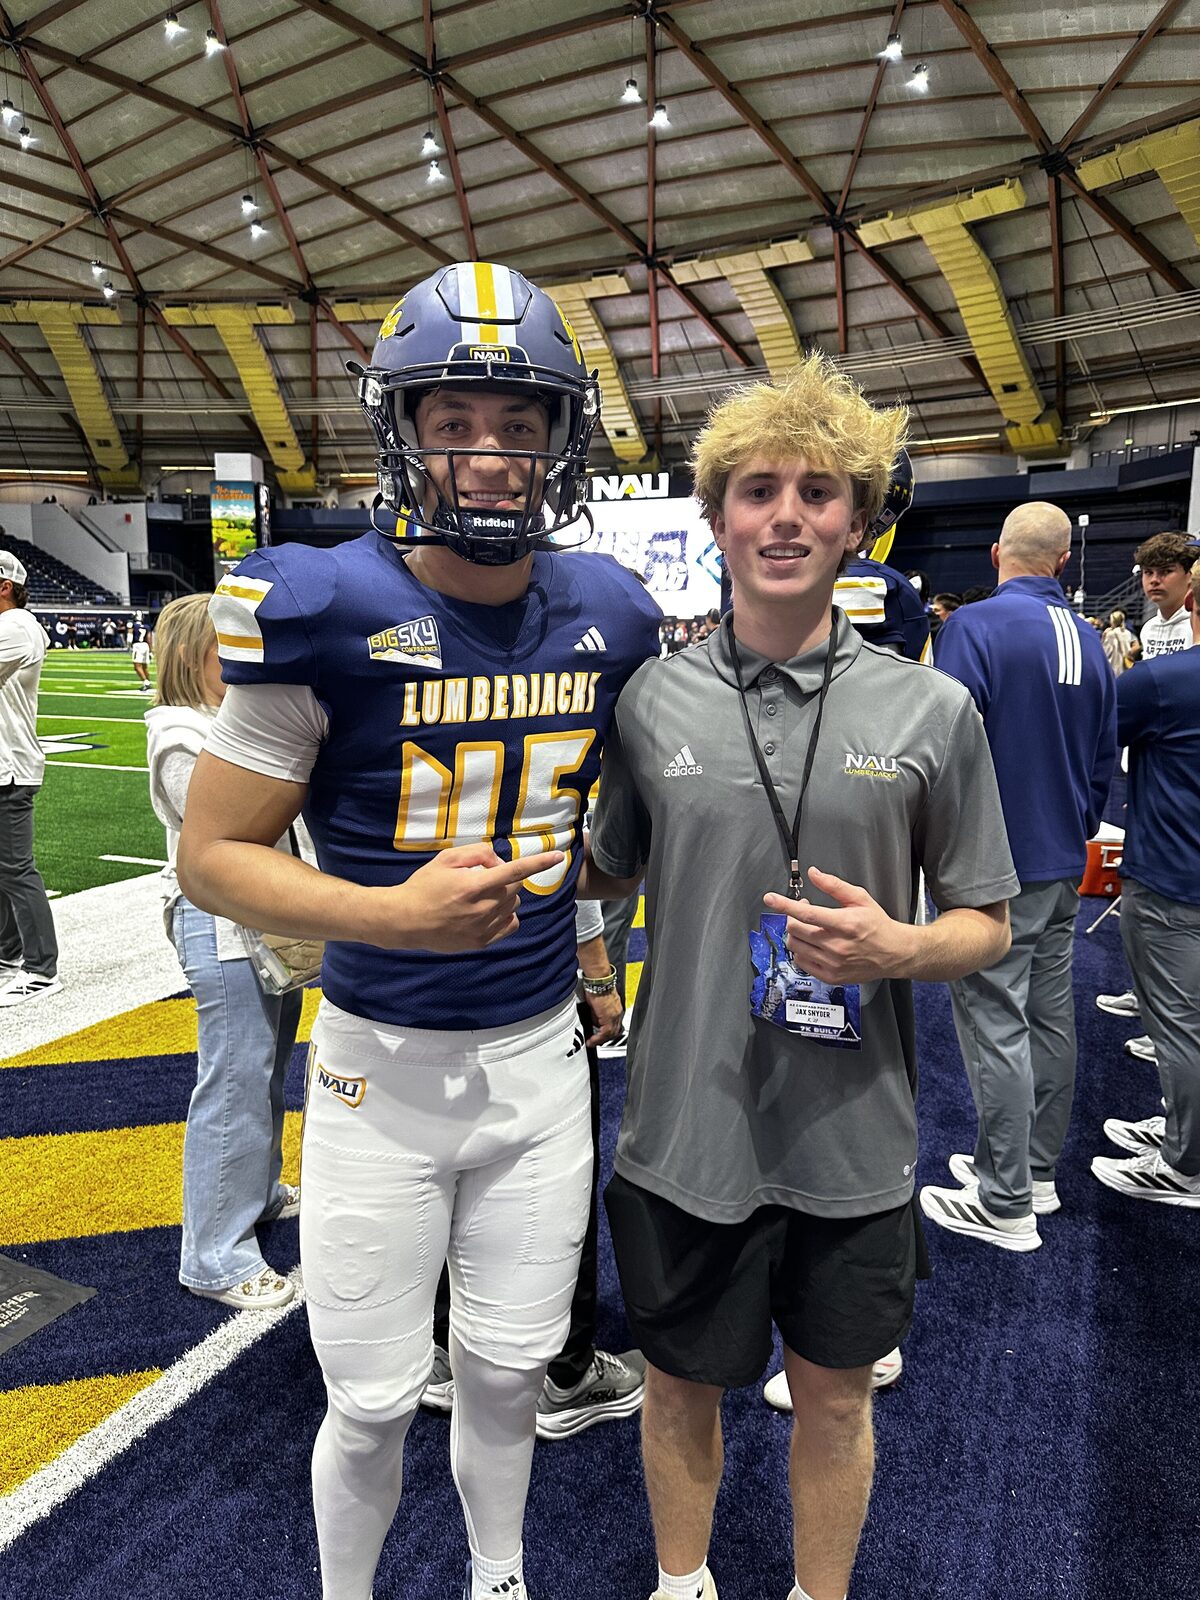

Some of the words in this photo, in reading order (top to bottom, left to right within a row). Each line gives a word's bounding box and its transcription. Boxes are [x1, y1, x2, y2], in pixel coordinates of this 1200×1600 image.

[473, 351, 506, 362] NAU
[591, 472, 670, 501] NAU
[473, 517, 515, 529] Riddell
[370, 629, 398, 649] BIG
[397, 618, 434, 647] SKY
[401, 645, 438, 653] CONFERENCE
[400, 671, 602, 727] LUMBERJACKS
[846, 753, 897, 771] NAU
[663, 764, 704, 778] adidas
[844, 767, 898, 779] LUMBERJACKS
[807, 1010, 831, 1018] SNYDER
[318, 1070, 359, 1098] NAU
[585, 1387, 617, 1402] HOKA
